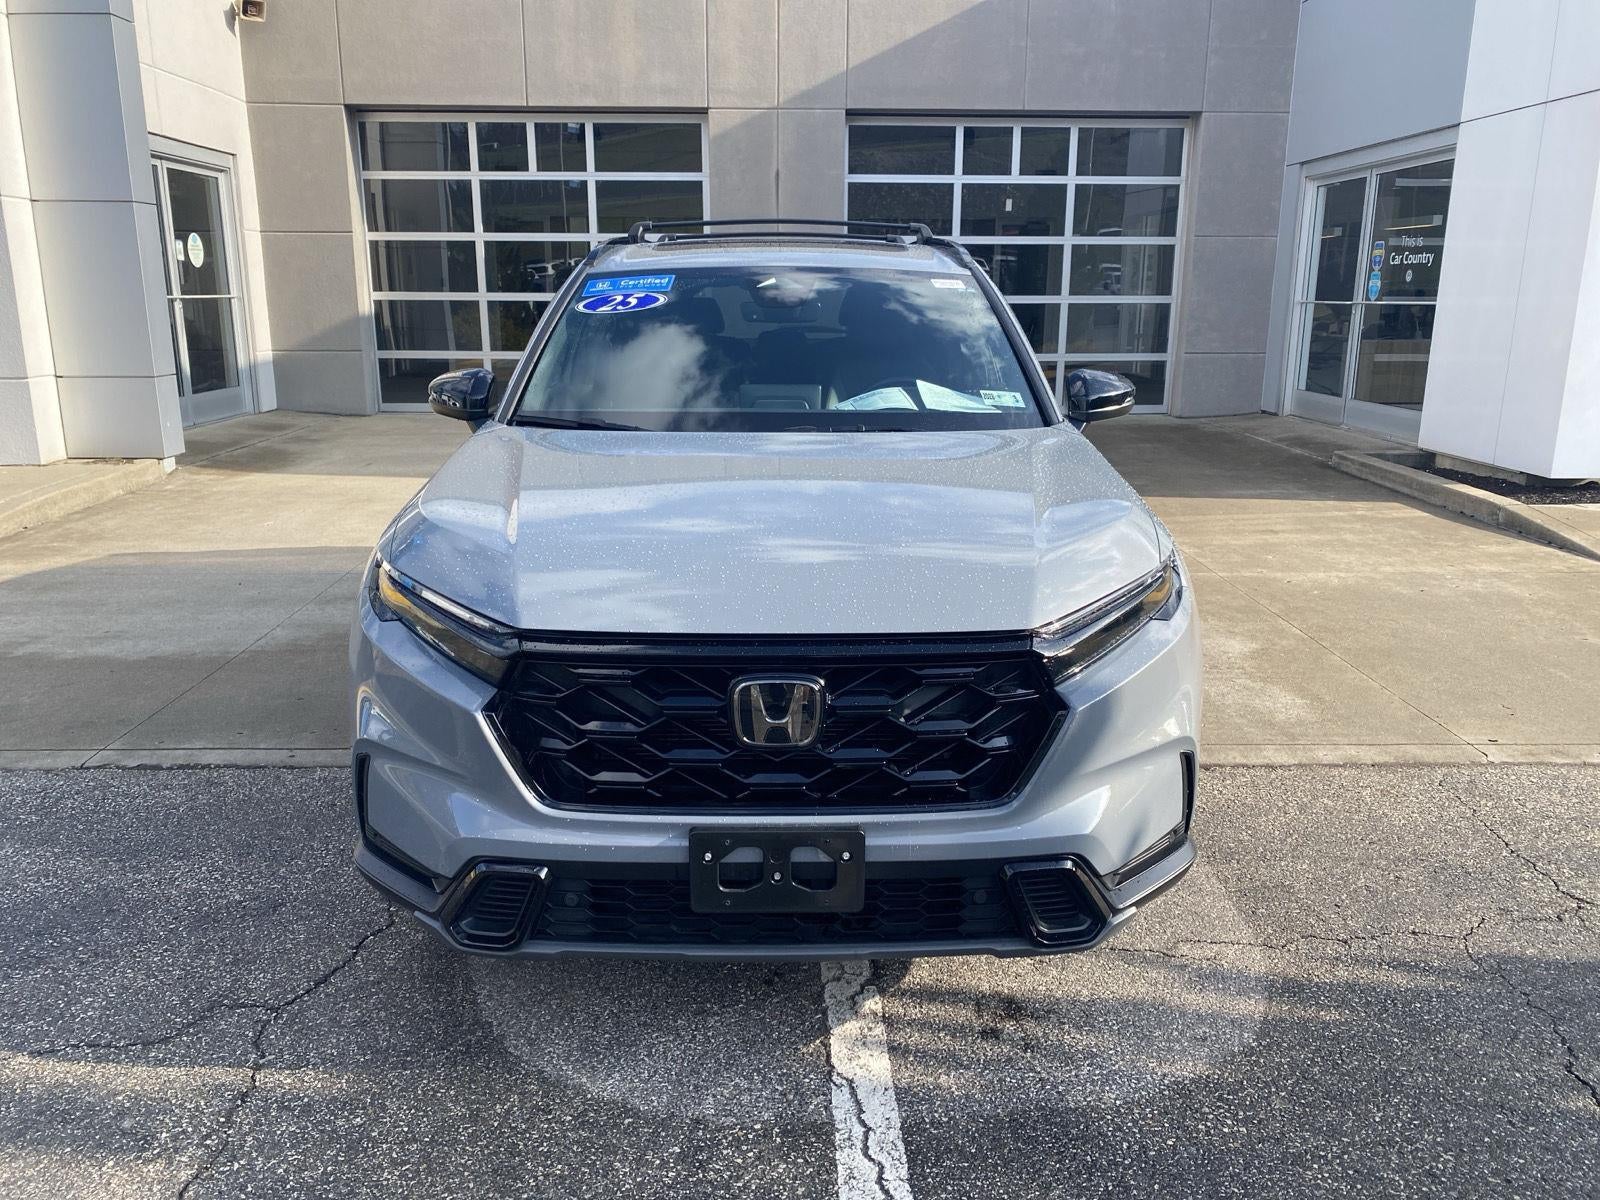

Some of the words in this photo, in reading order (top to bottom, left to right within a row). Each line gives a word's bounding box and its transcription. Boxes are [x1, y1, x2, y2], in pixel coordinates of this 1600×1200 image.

[1401, 235, 1416, 248] This
[1416, 235, 1424, 247] is
[1389, 252, 1402, 265] Car
[1403, 251, 1434, 267] Country
[620, 277, 669, 286] Certified
[595, 293, 646, 312] 25
